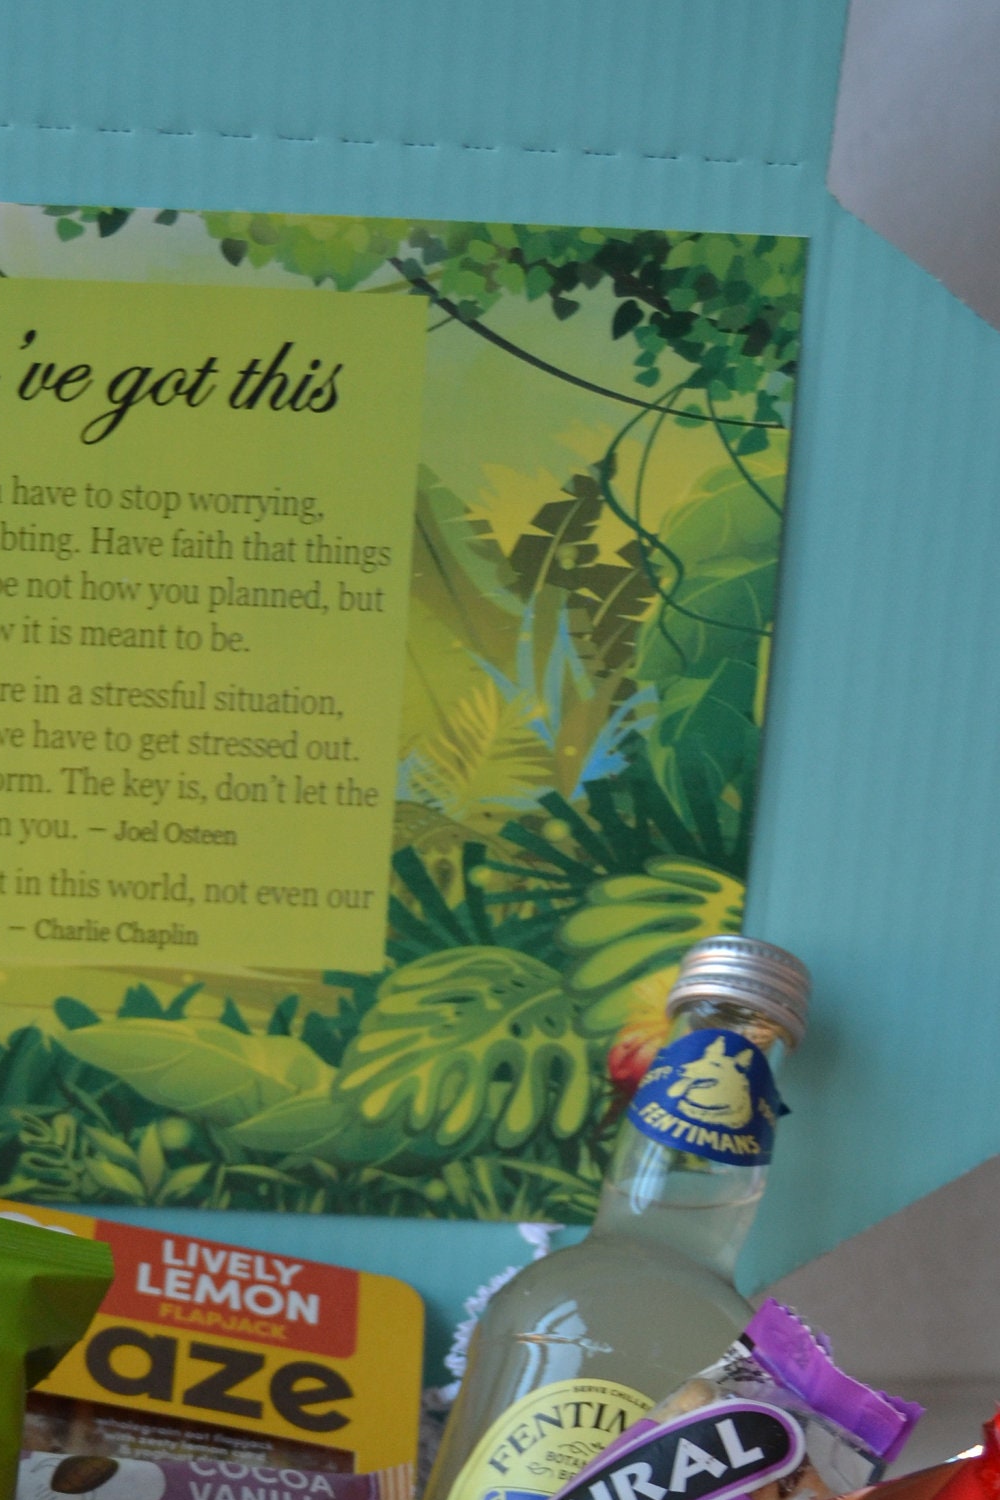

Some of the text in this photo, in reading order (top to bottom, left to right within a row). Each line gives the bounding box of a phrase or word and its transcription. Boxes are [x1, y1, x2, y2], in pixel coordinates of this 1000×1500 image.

[80, 357, 217, 445] got
[228, 341, 344, 415] this
[11, 472, 78, 507] have
[83, 482, 114, 509] to
[118, 484, 183, 520] stop
[187, 486, 325, 526] worrying,
[89, 524, 165, 557] Have
[171, 526, 234, 561] faith
[241, 529, 298, 563] that
[304, 532, 392, 574] things
[25, 573, 73, 600] not
[79, 569, 143, 602] how
[145, 581, 200, 611] you
[206, 574, 330, 615] planned,
[337, 579, 386, 614] but
[21, 614, 42, 645] it
[49, 615, 73, 646] is
[79, 624, 168, 650] meant
[174, 624, 204, 652] to
[210, 619, 251, 653] be.
[32, 674, 61, 705] in
[66, 683, 84, 706] a
[89, 678, 207, 711] stressful
[213, 682, 345, 719] situation,
[32, 718, 98, 752] have
[103, 726, 133, 753] to
[137, 728, 181, 762] get
[186, 727, 299, 760] stressed
[305, 735, 360, 762] out.
[59, 765, 116, 798] The
[121, 766, 172, 806] key
[177, 770, 209, 804] is,
[214, 770, 287, 805] don't
[293, 774, 328, 806] let
[334, 775, 377, 808] the
[17, 816, 79, 845] you.
[112, 817, 160, 844] Joel
[162, 820, 239, 847] Osteen
[14, 866, 42, 897] in
[48, 866, 101, 899] this
[106, 871, 196, 907] world,
[203, 880, 249, 906] not
[255, 884, 319, 908] even
[325, 887, 375, 910] our
[32, 916, 112, 944] Charlie
[113, 919, 200, 948] Chaplin
[638, 1101, 761, 1155] FENTIMANS
[162, 1238, 303, 1287] LIVELY
[136, 1262, 322, 1326] LEMON
[158, 1302, 288, 1342] FLAPJACK
[84, 1324, 355, 1434] aze
[610, 1388, 650, 1411] CHILLE
[487, 1401, 630, 1476] FENTI
[188, 1462, 337, 1499] COCOA
